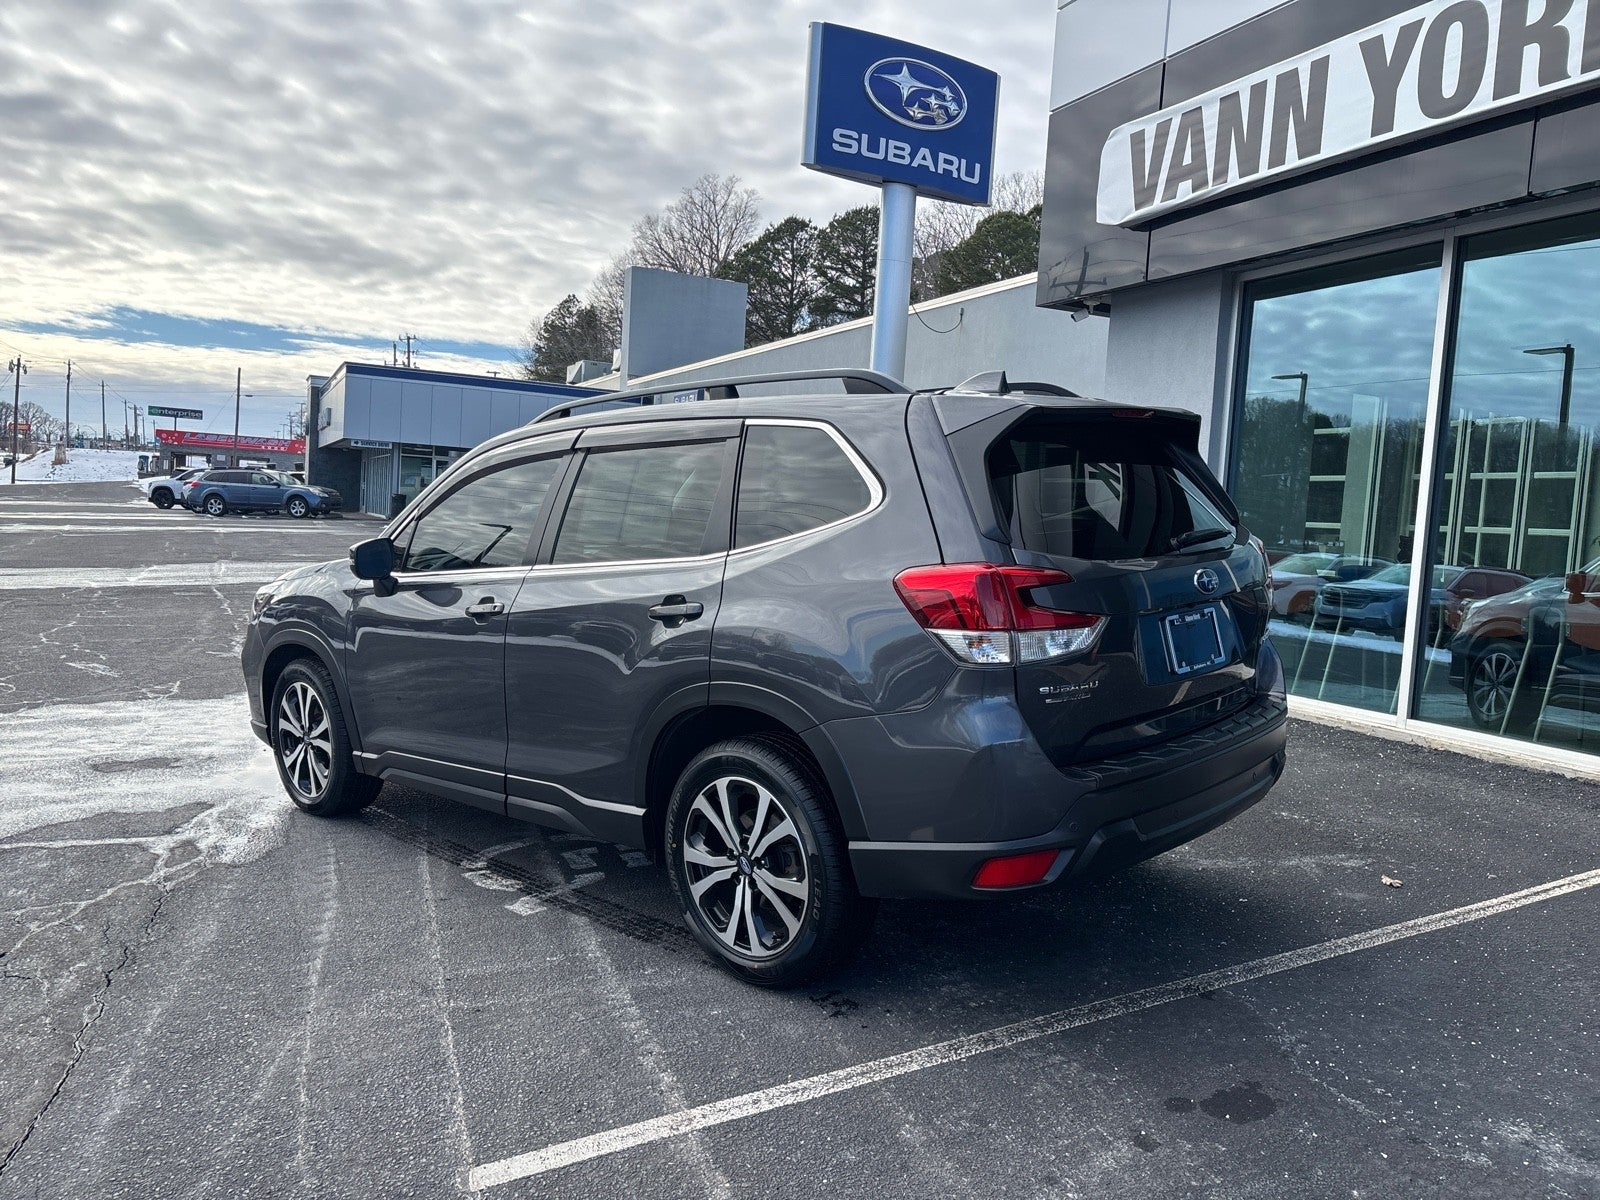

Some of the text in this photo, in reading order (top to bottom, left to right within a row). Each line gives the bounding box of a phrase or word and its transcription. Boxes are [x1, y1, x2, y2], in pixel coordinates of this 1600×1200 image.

[1129, 54, 1330, 212] VANN
[832, 128, 980, 184] SUBARU
[151, 407, 202, 418] enterprise
[1039, 681, 1099, 694] SUBARU
